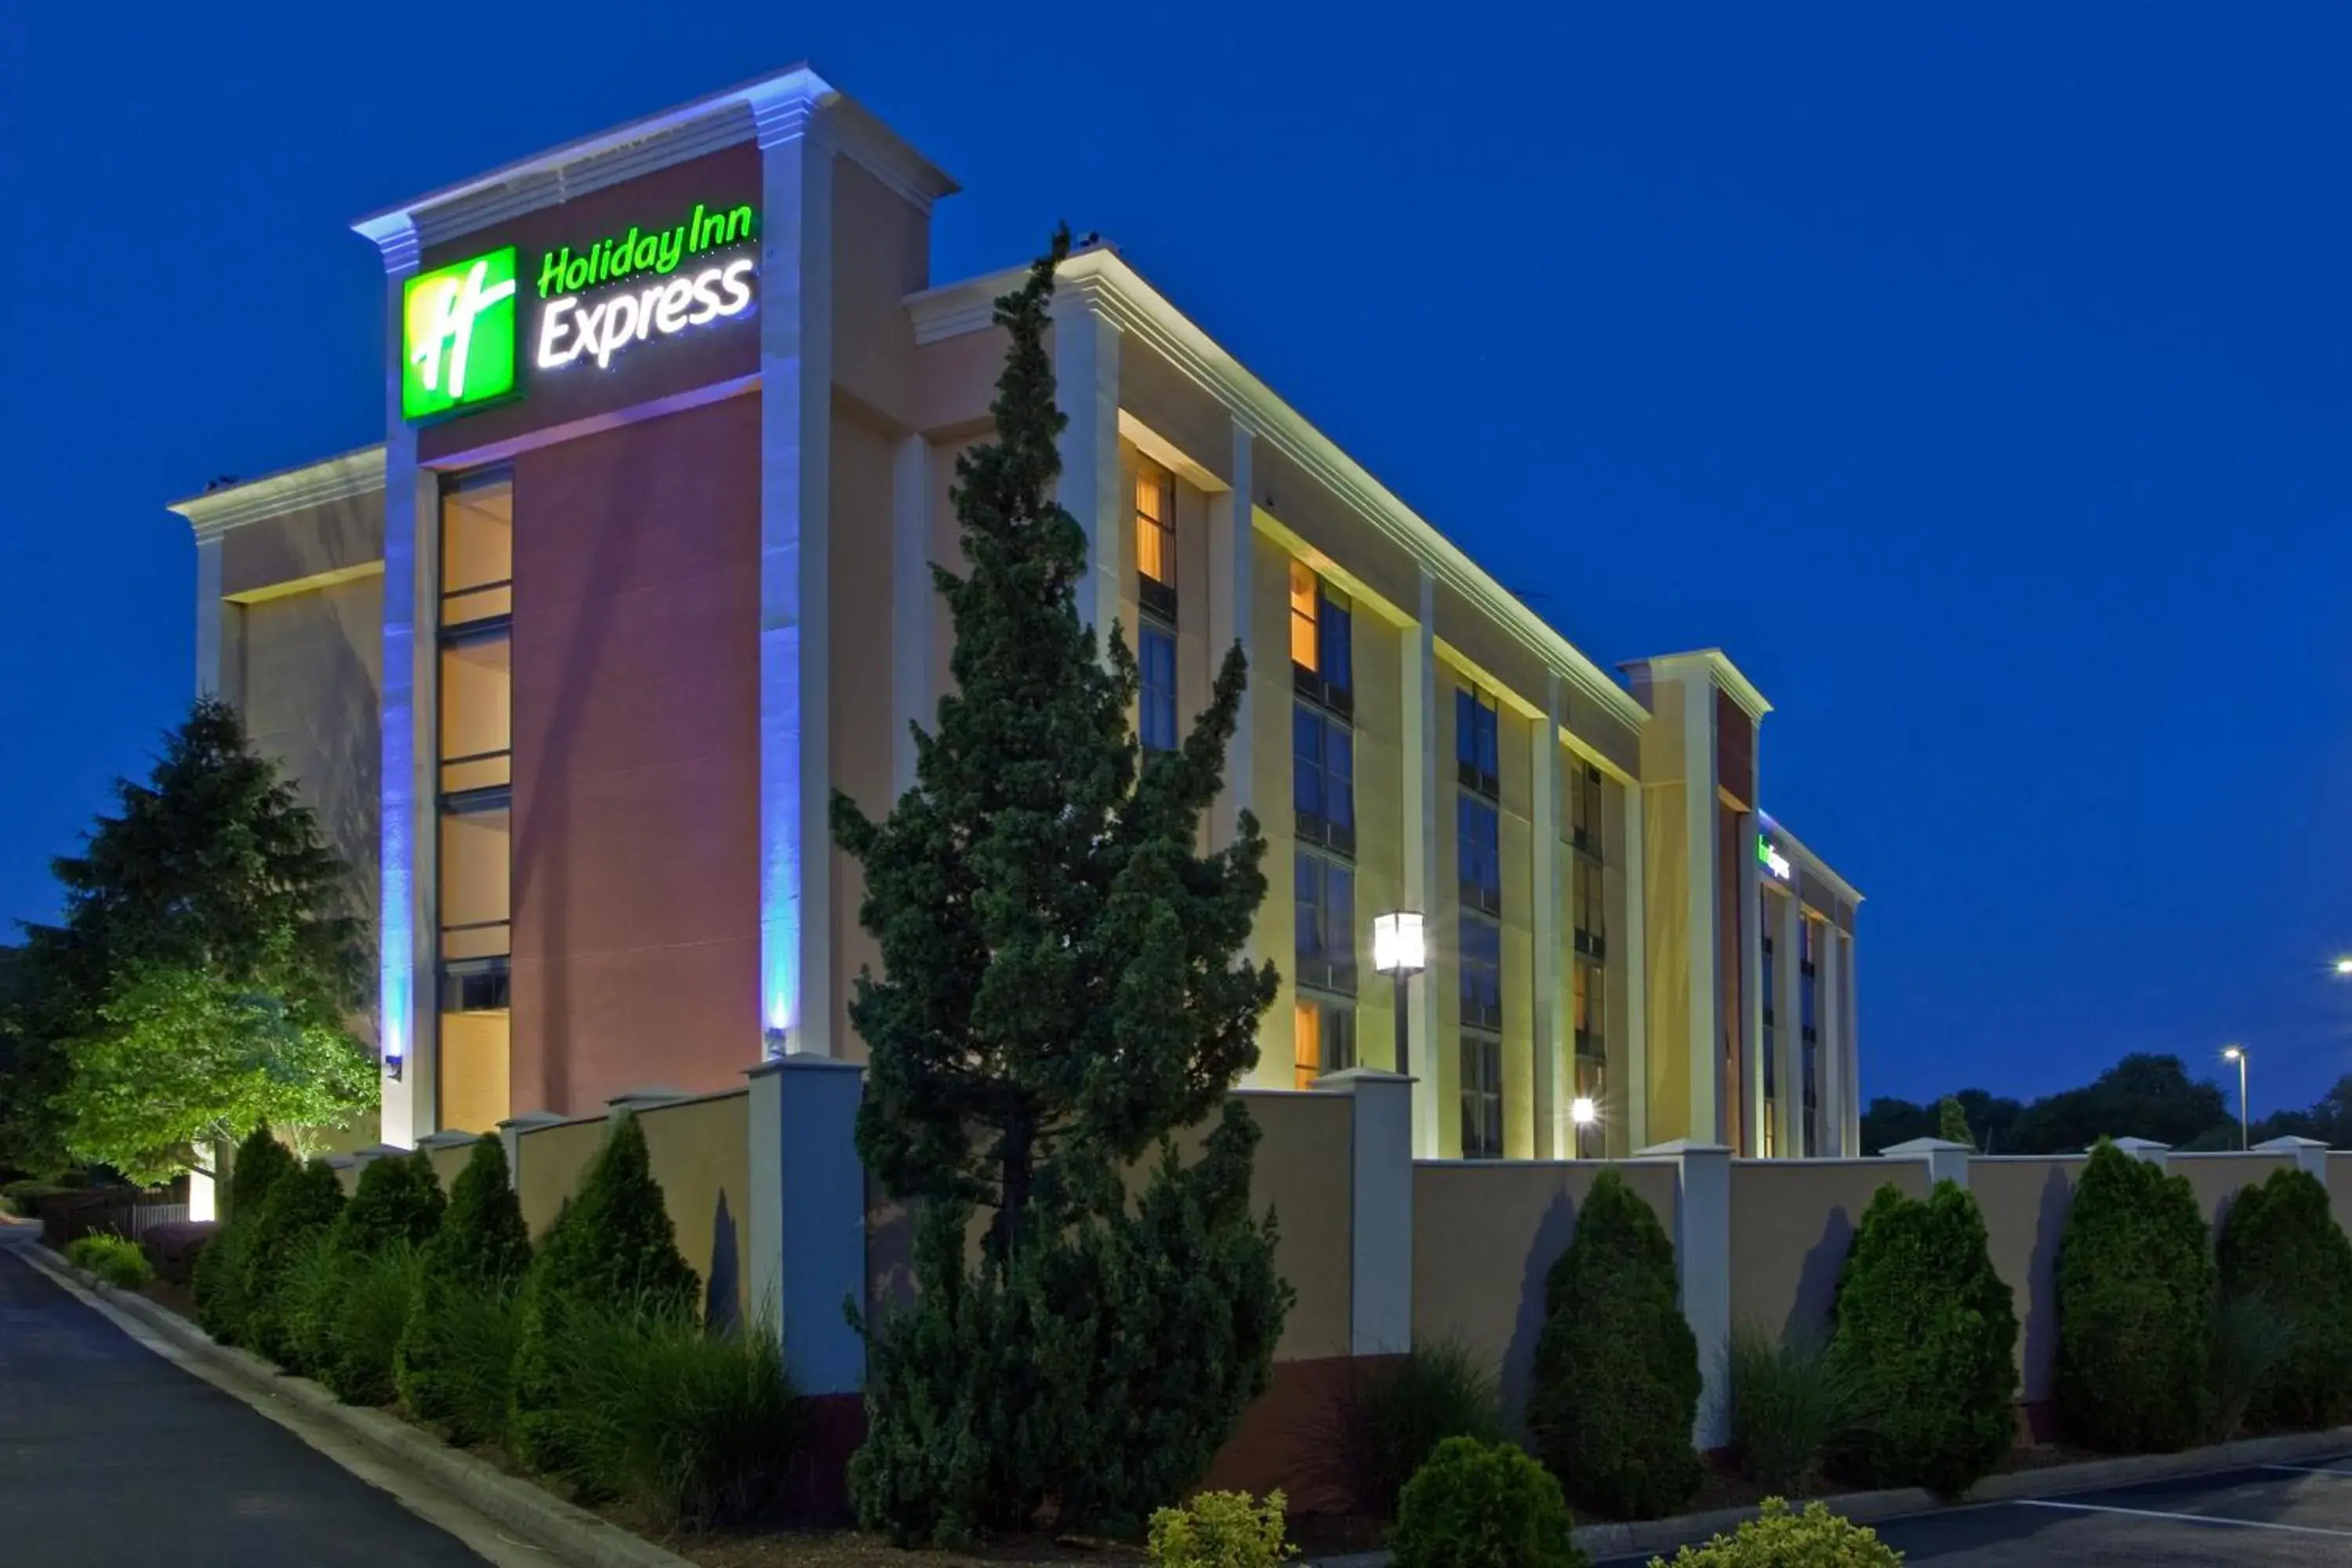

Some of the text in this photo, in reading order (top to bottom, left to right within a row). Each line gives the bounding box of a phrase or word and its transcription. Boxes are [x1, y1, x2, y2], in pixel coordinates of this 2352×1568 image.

[538, 205, 752, 298] Holiday Inn
[537, 260, 753, 368] Express
